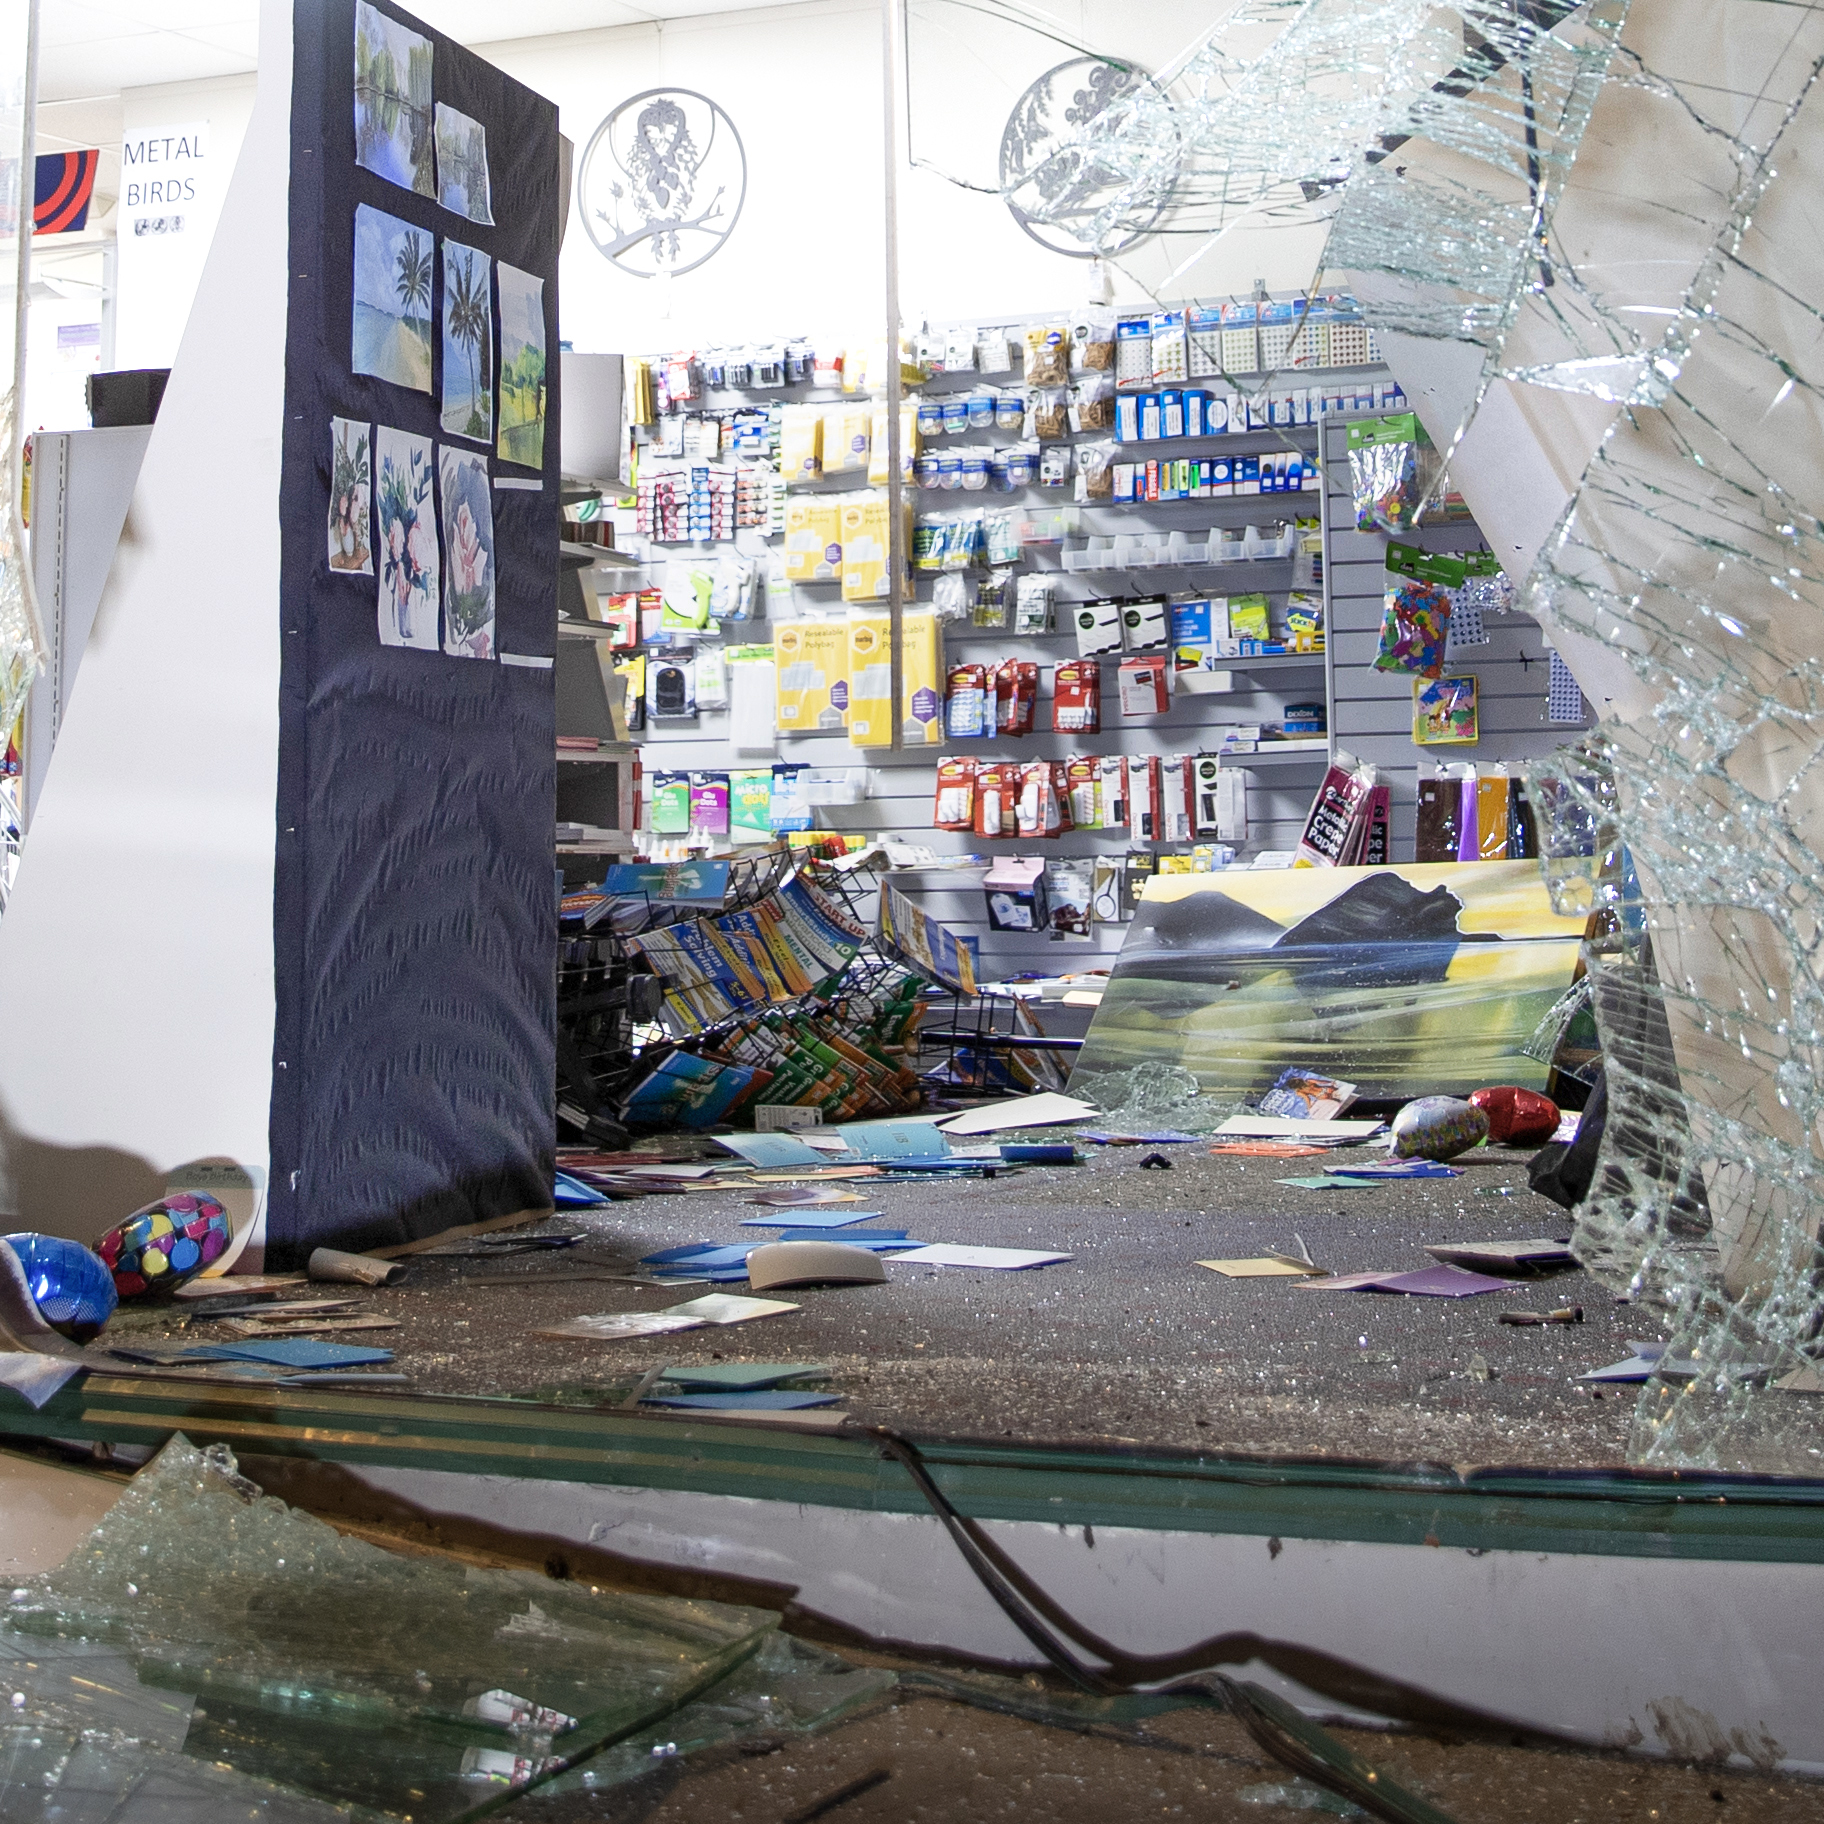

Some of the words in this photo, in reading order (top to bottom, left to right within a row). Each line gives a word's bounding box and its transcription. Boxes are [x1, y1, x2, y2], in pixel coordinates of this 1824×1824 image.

[123, 135, 205, 166] METAL
[126, 177, 196, 207] BIRDS
[1287, 710, 1314, 718] DIXON
[1307, 826, 1341, 857] Paper
[1313, 815, 1345, 845] Crepe
[787, 906, 834, 955] Advanced
[813, 893, 847, 928] START
[847, 922, 867, 938] UP
[682, 933, 719, 980] Solving
[685, 919, 725, 970] Problem
[783, 933, 814, 970] MENTAL
[788, 916, 835, 964] athematics
[835, 941, 852, 957] 10
